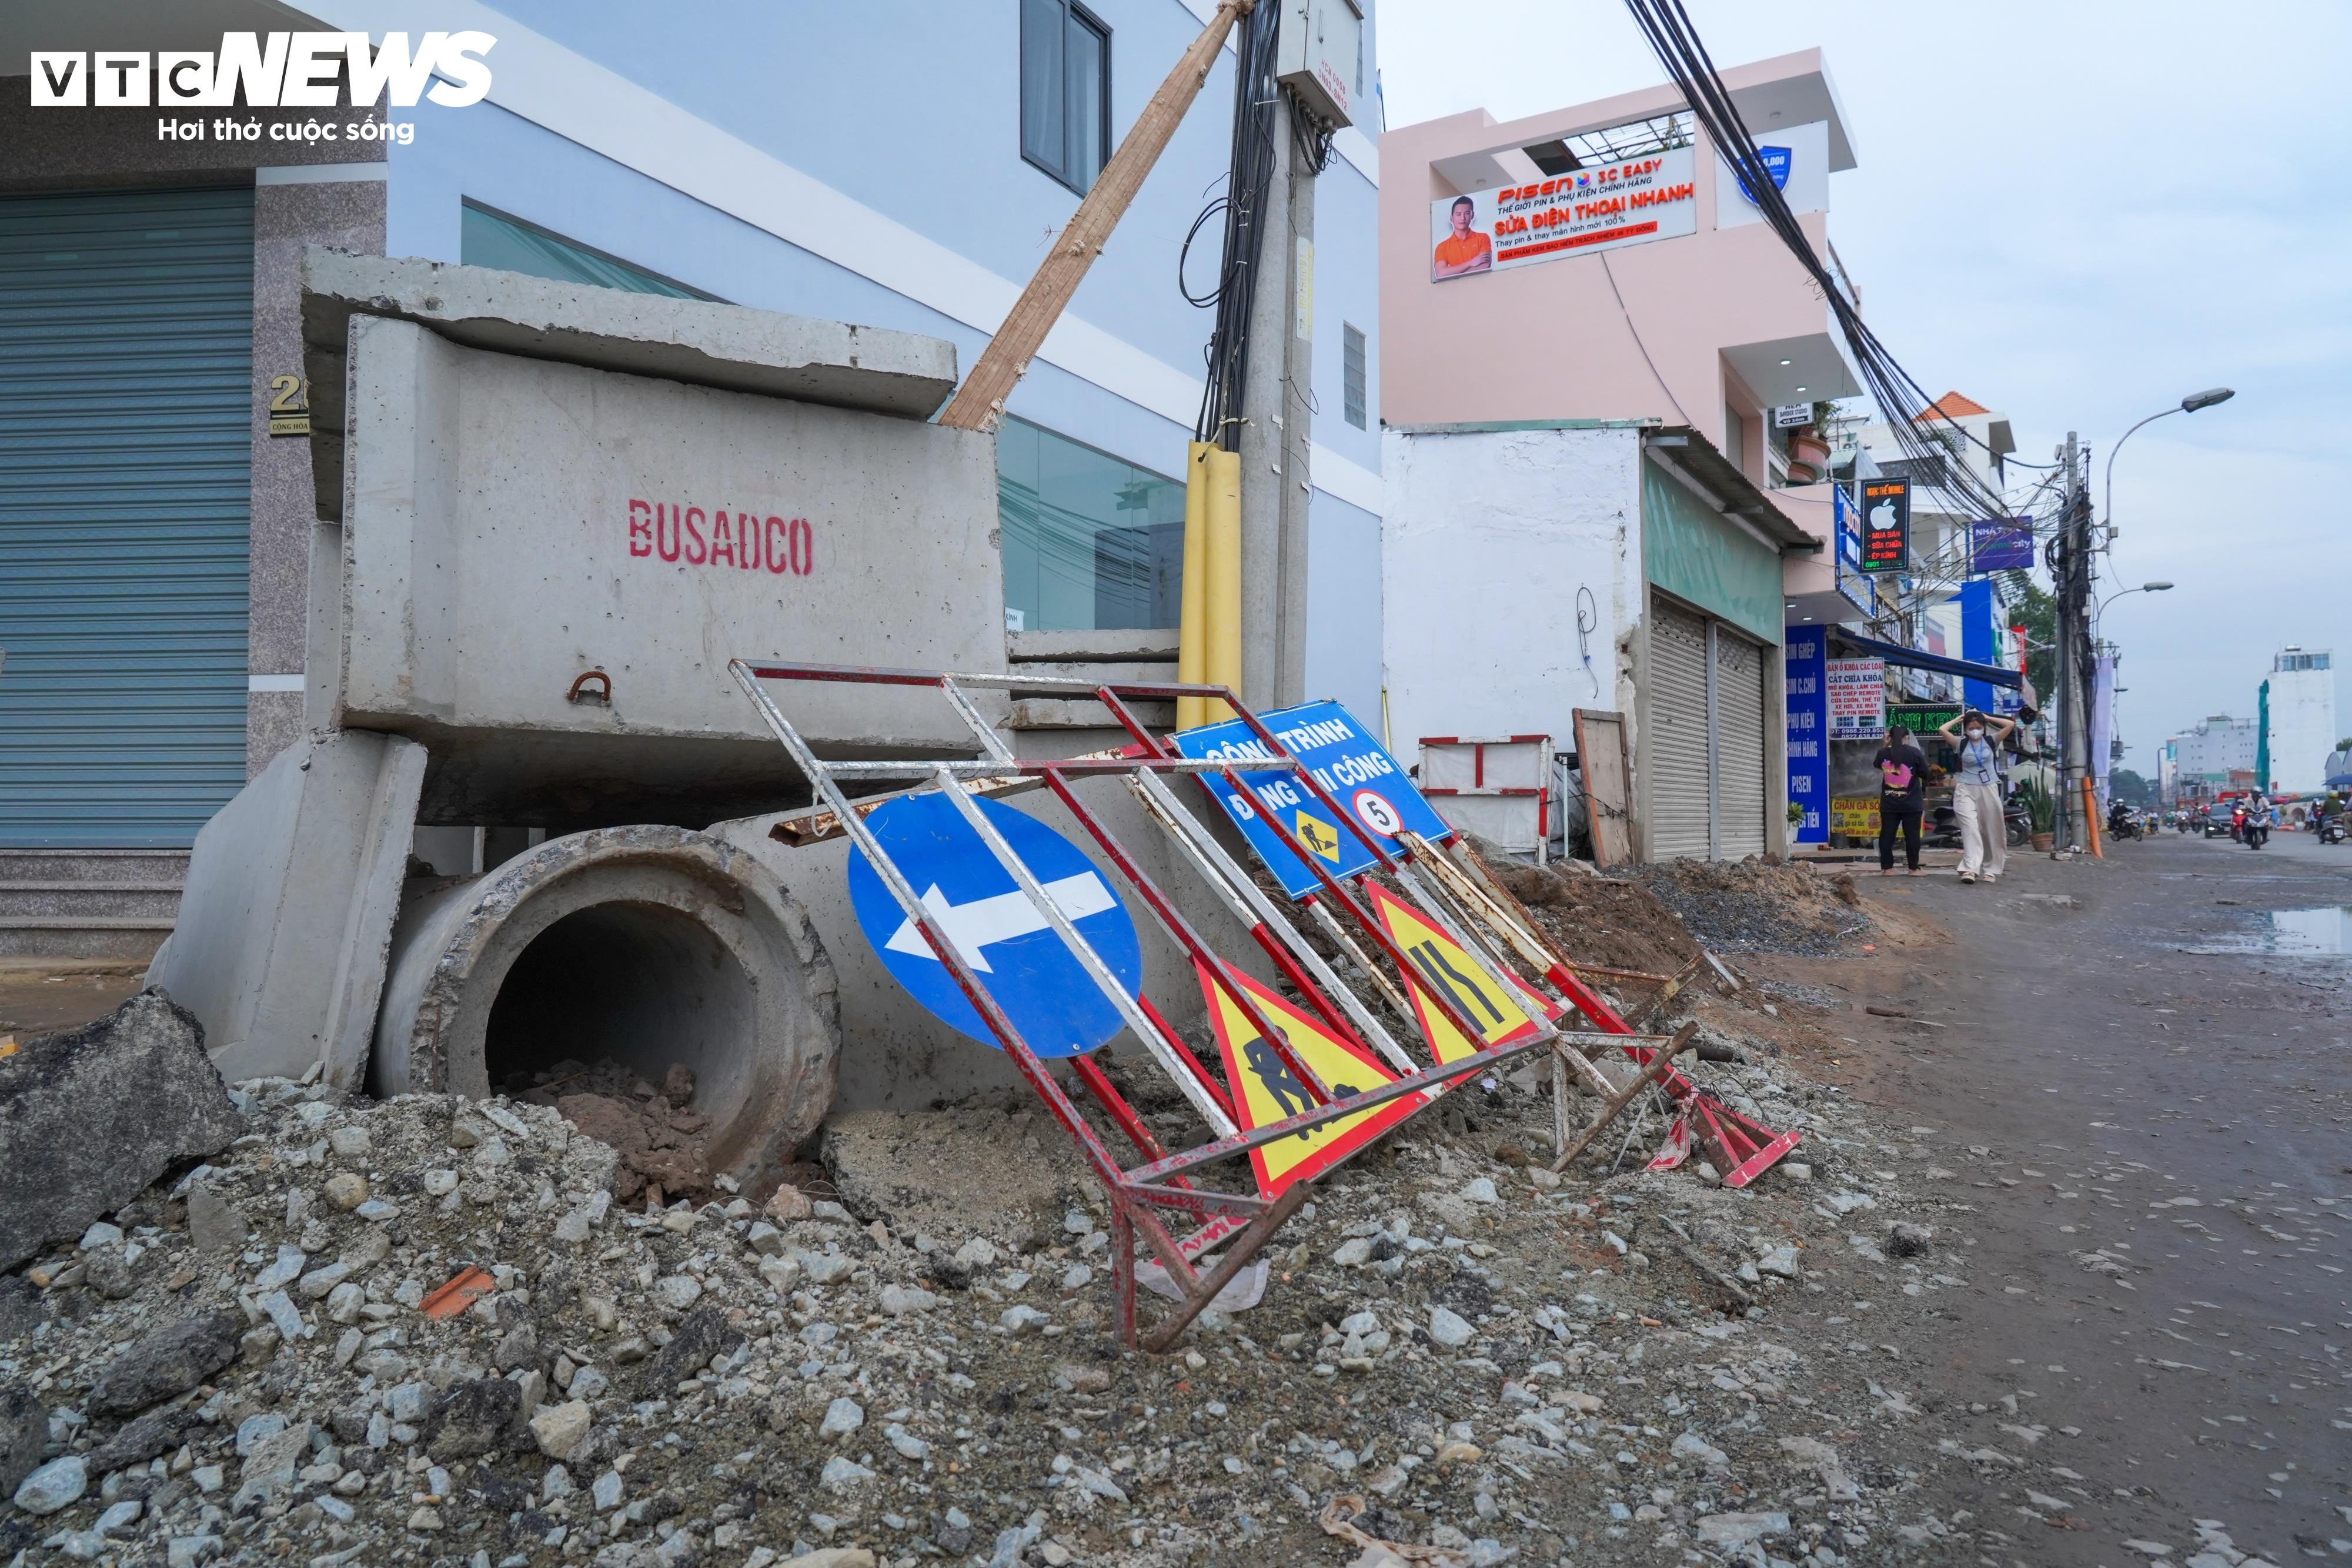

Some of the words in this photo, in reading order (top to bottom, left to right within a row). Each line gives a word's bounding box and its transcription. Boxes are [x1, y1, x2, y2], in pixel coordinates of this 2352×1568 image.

[1321, 57, 1332, 77] HCM
[1333, 72, 1345, 95] 0058
[1598, 168, 1618, 183] 3C
[1623, 158, 1663, 178] EASY
[1495, 214, 1528, 236] SỬA
[1532, 207, 1570, 229] ĐIỆN
[1575, 195, 1626, 220] THOẠI
[1630, 182, 1693, 210] NHANH
[1498, 202, 1515, 215] THẾ
[1515, 200, 1531, 211] GIỚI
[1534, 198, 1548, 208] PIN
[1558, 192, 1575, 202] PHỤ
[1577, 188, 1597, 199] KIỆN
[1599, 182, 1625, 194] CHÍNH
[1628, 176, 1652, 188] HÃNG
[1495, 239, 1512, 248] Thay
[1515, 236, 1525, 245] pin
[1535, 232, 1550, 240] thay
[1570, 225, 1585, 233] hình
[1587, 220, 1601, 230] mới
[270, 375, 309, 410] 2
[272, 423, 292, 432] CỘNG
[293, 421, 309, 430] HÒA
[629, 499, 813, 576] BUSADCO
[1785, 644, 1797, 660] SIM
[1799, 639, 1815, 659] GHÉP
[1829, 673, 1843, 683] CẮT
[1844, 673, 1861, 683] CHÌA
[1863, 673, 1883, 682] KHÓA
[1844, 662, 1859, 671] KHÓA
[1860, 661, 1870, 670] CÁC
[1786, 678, 1796, 695] SIM
[1787, 713, 1799, 733] PHỤ
[1800, 708, 1815, 733] KIỆN
[1275, 718, 1355, 753] TRÌNH
[1227, 780, 1301, 821] ĐNG
[1332, 751, 1395, 787] CÔNG
[1792, 775, 1812, 793] PISEN
[1367, 800, 1391, 827] 5
